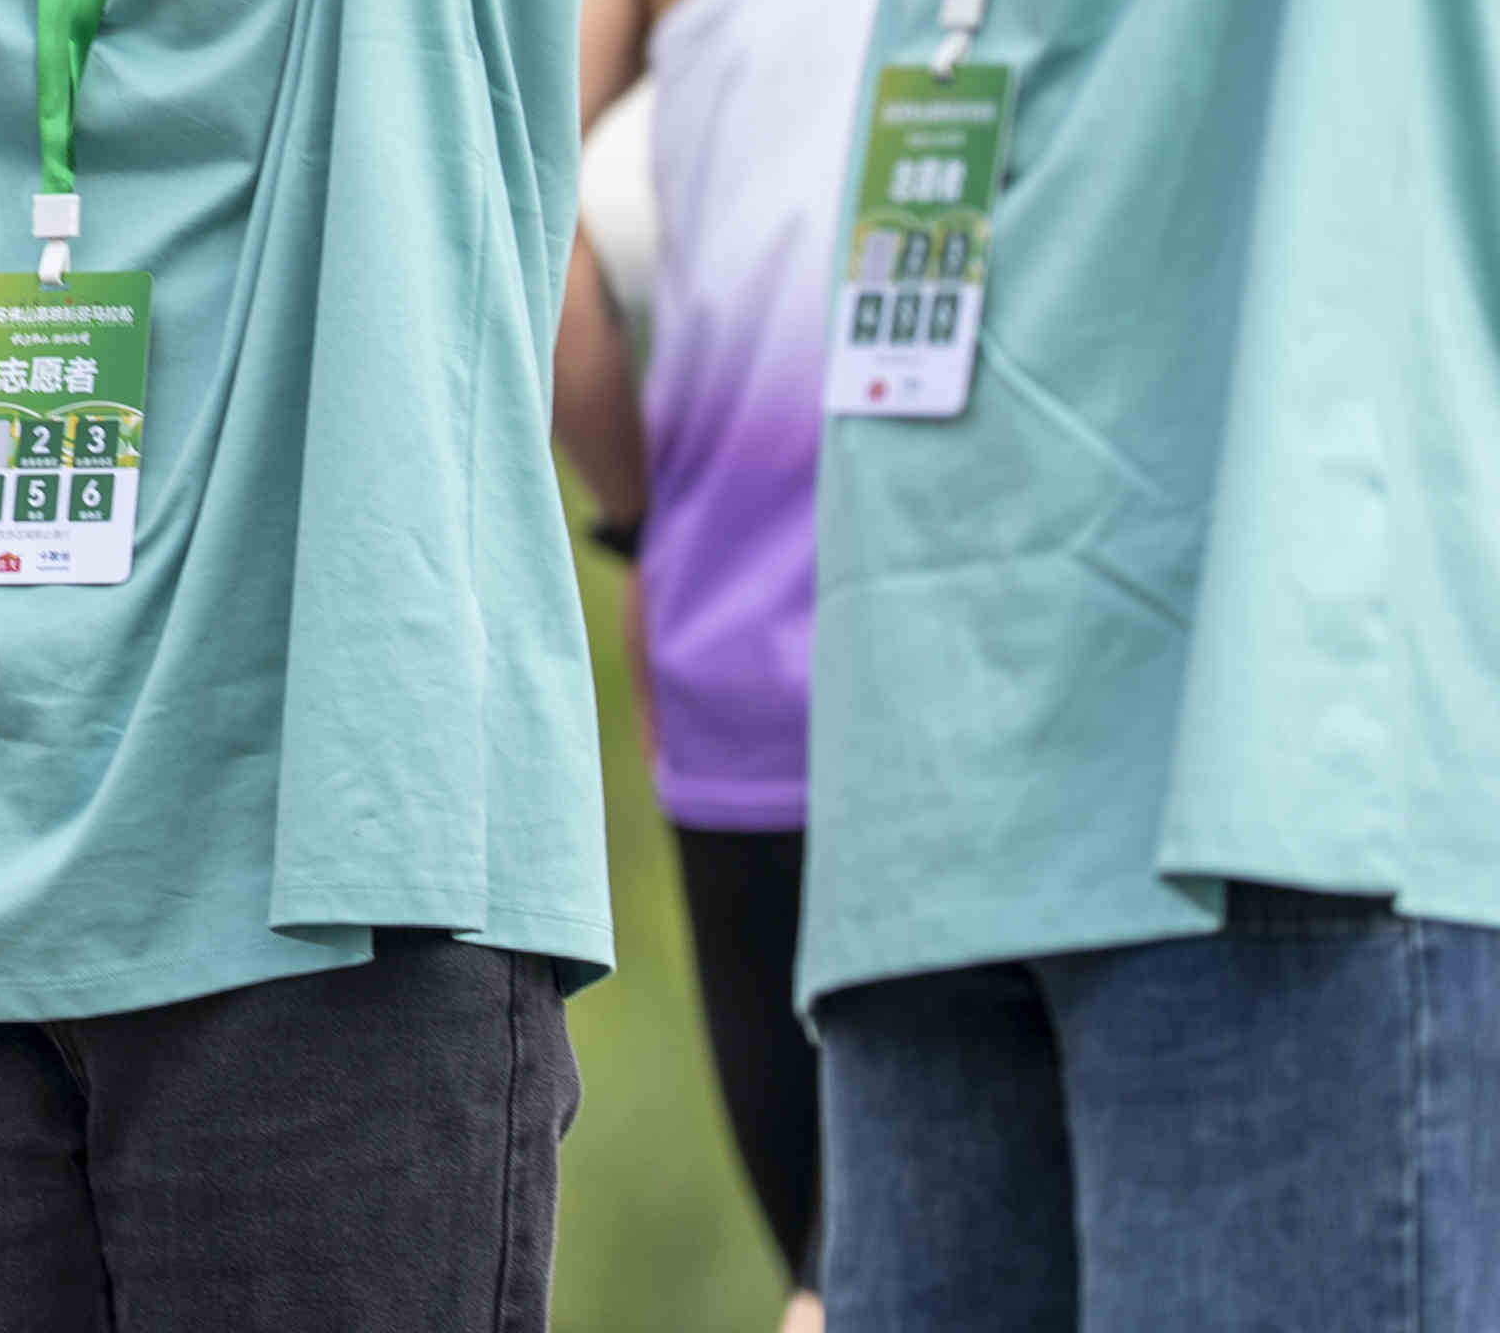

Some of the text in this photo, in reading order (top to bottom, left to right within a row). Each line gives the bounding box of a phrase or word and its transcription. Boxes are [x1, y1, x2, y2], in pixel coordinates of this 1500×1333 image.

[30, 425, 51, 455] 2
[85, 425, 106, 455] 3
[27, 479, 47, 508] 5
[81, 478, 102, 508] 6
